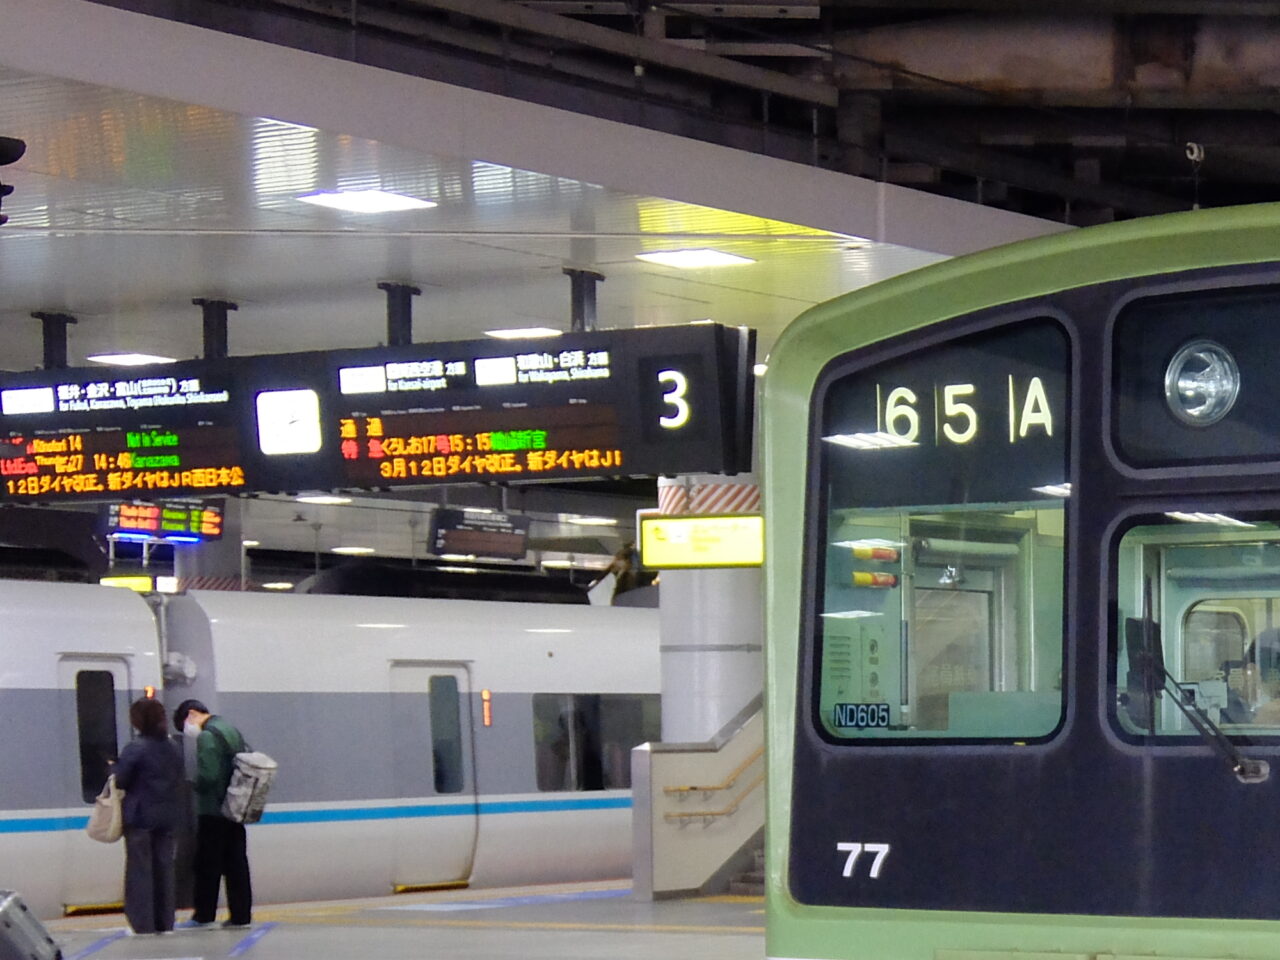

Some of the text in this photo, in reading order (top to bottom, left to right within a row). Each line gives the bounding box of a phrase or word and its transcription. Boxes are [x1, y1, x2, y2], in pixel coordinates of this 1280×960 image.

[657, 370, 690, 428] 3
[835, 703, 889, 728] ND605
[837, 842, 890, 879] 77
